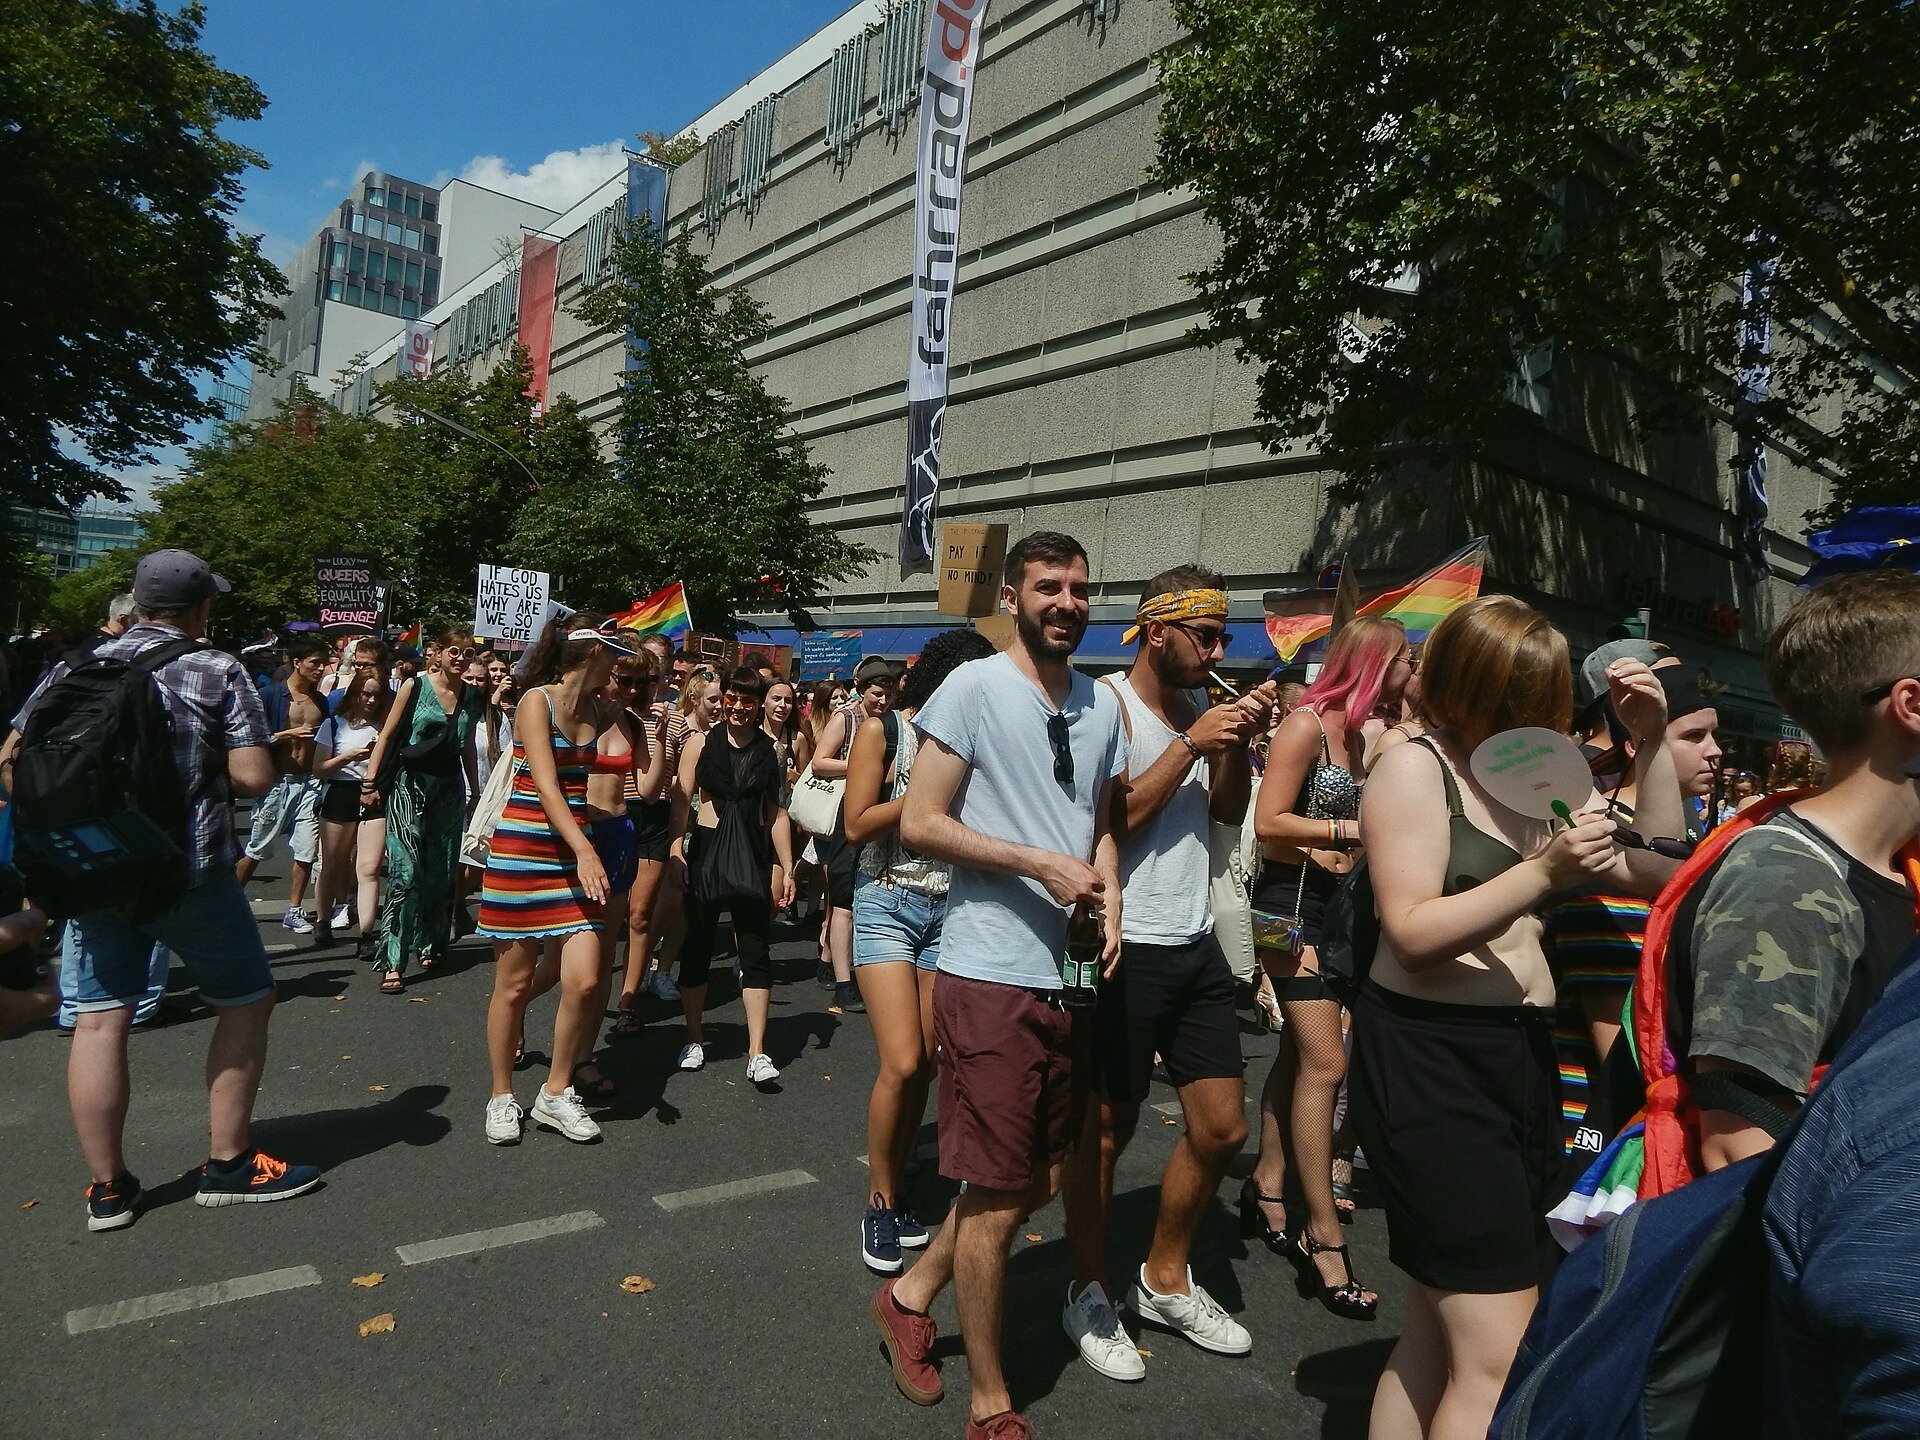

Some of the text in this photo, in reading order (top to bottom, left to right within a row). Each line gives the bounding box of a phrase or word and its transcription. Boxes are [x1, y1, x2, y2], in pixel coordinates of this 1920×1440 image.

[917, 0, 976, 370] fahrrad.d
[949, 545, 989, 559] PAY IT
[332, 557, 356, 567] LUCKY
[318, 568, 370, 584] QUEERS
[489, 565, 538, 586] IF GOD
[947, 569, 993, 586] NO MIND!
[320, 589, 374, 603] EQUALITY
[480, 579, 543, 600] HATES US
[480, 594, 541, 615] WHY ARE
[320, 608, 378, 624] REVENGE!
[485, 610, 533, 629] WE SO
[501, 627, 531, 640] CUTE
